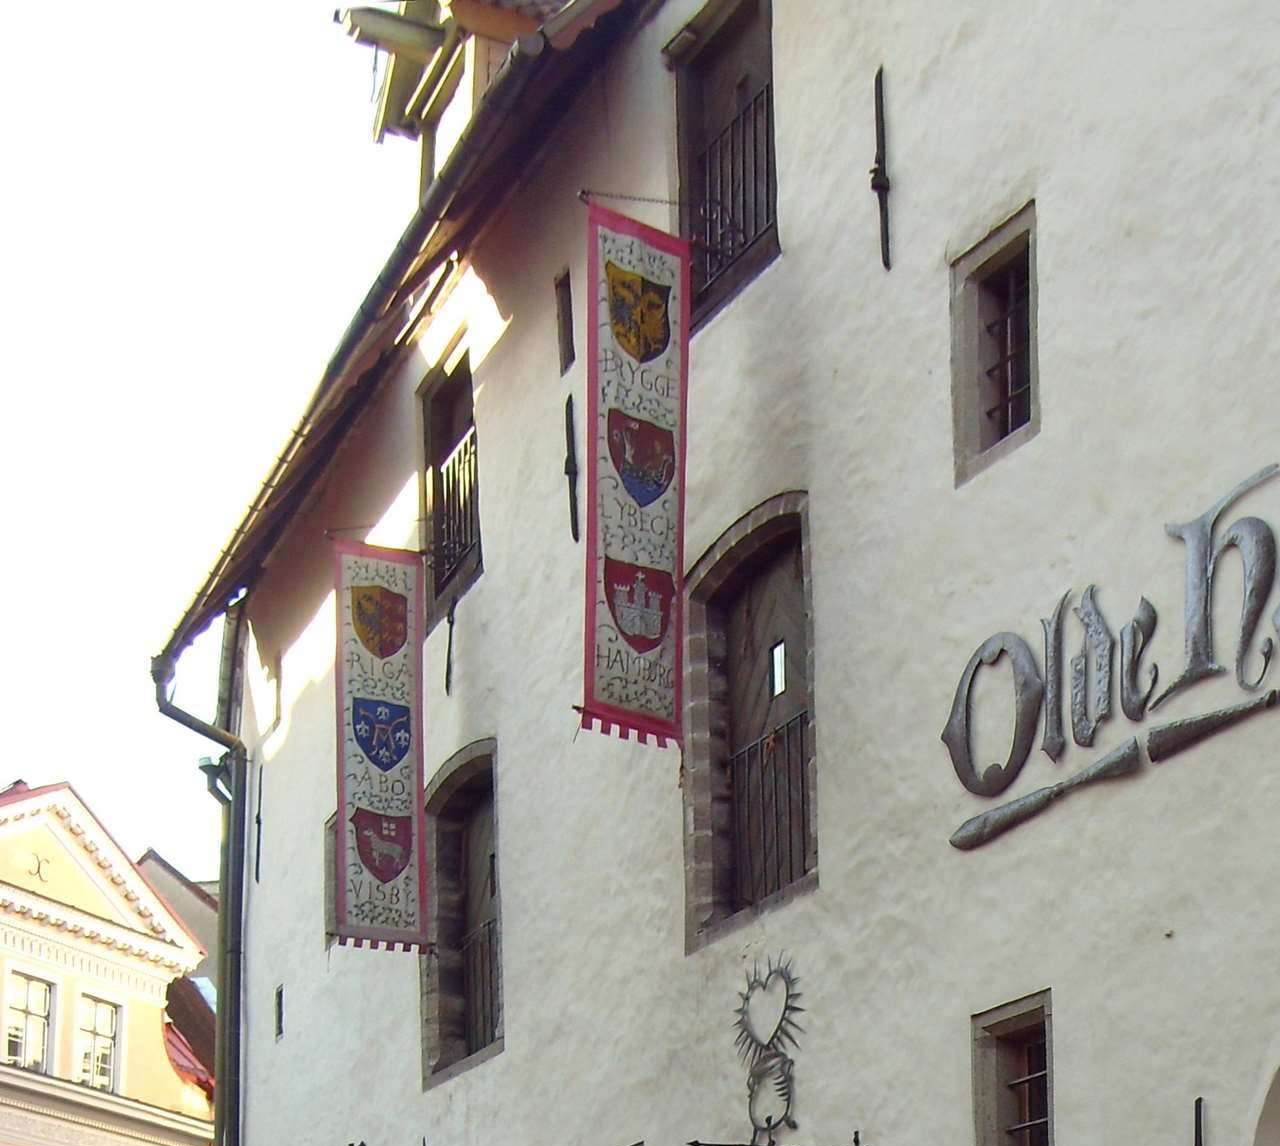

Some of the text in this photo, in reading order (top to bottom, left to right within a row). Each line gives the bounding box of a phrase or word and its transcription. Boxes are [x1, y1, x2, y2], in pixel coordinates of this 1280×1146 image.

[602, 348, 679, 400] BRYGGE
[348, 651, 410, 682] RIGA
[941, 584, 1159, 797] Olde
[350, 879, 412, 907] VISBY
